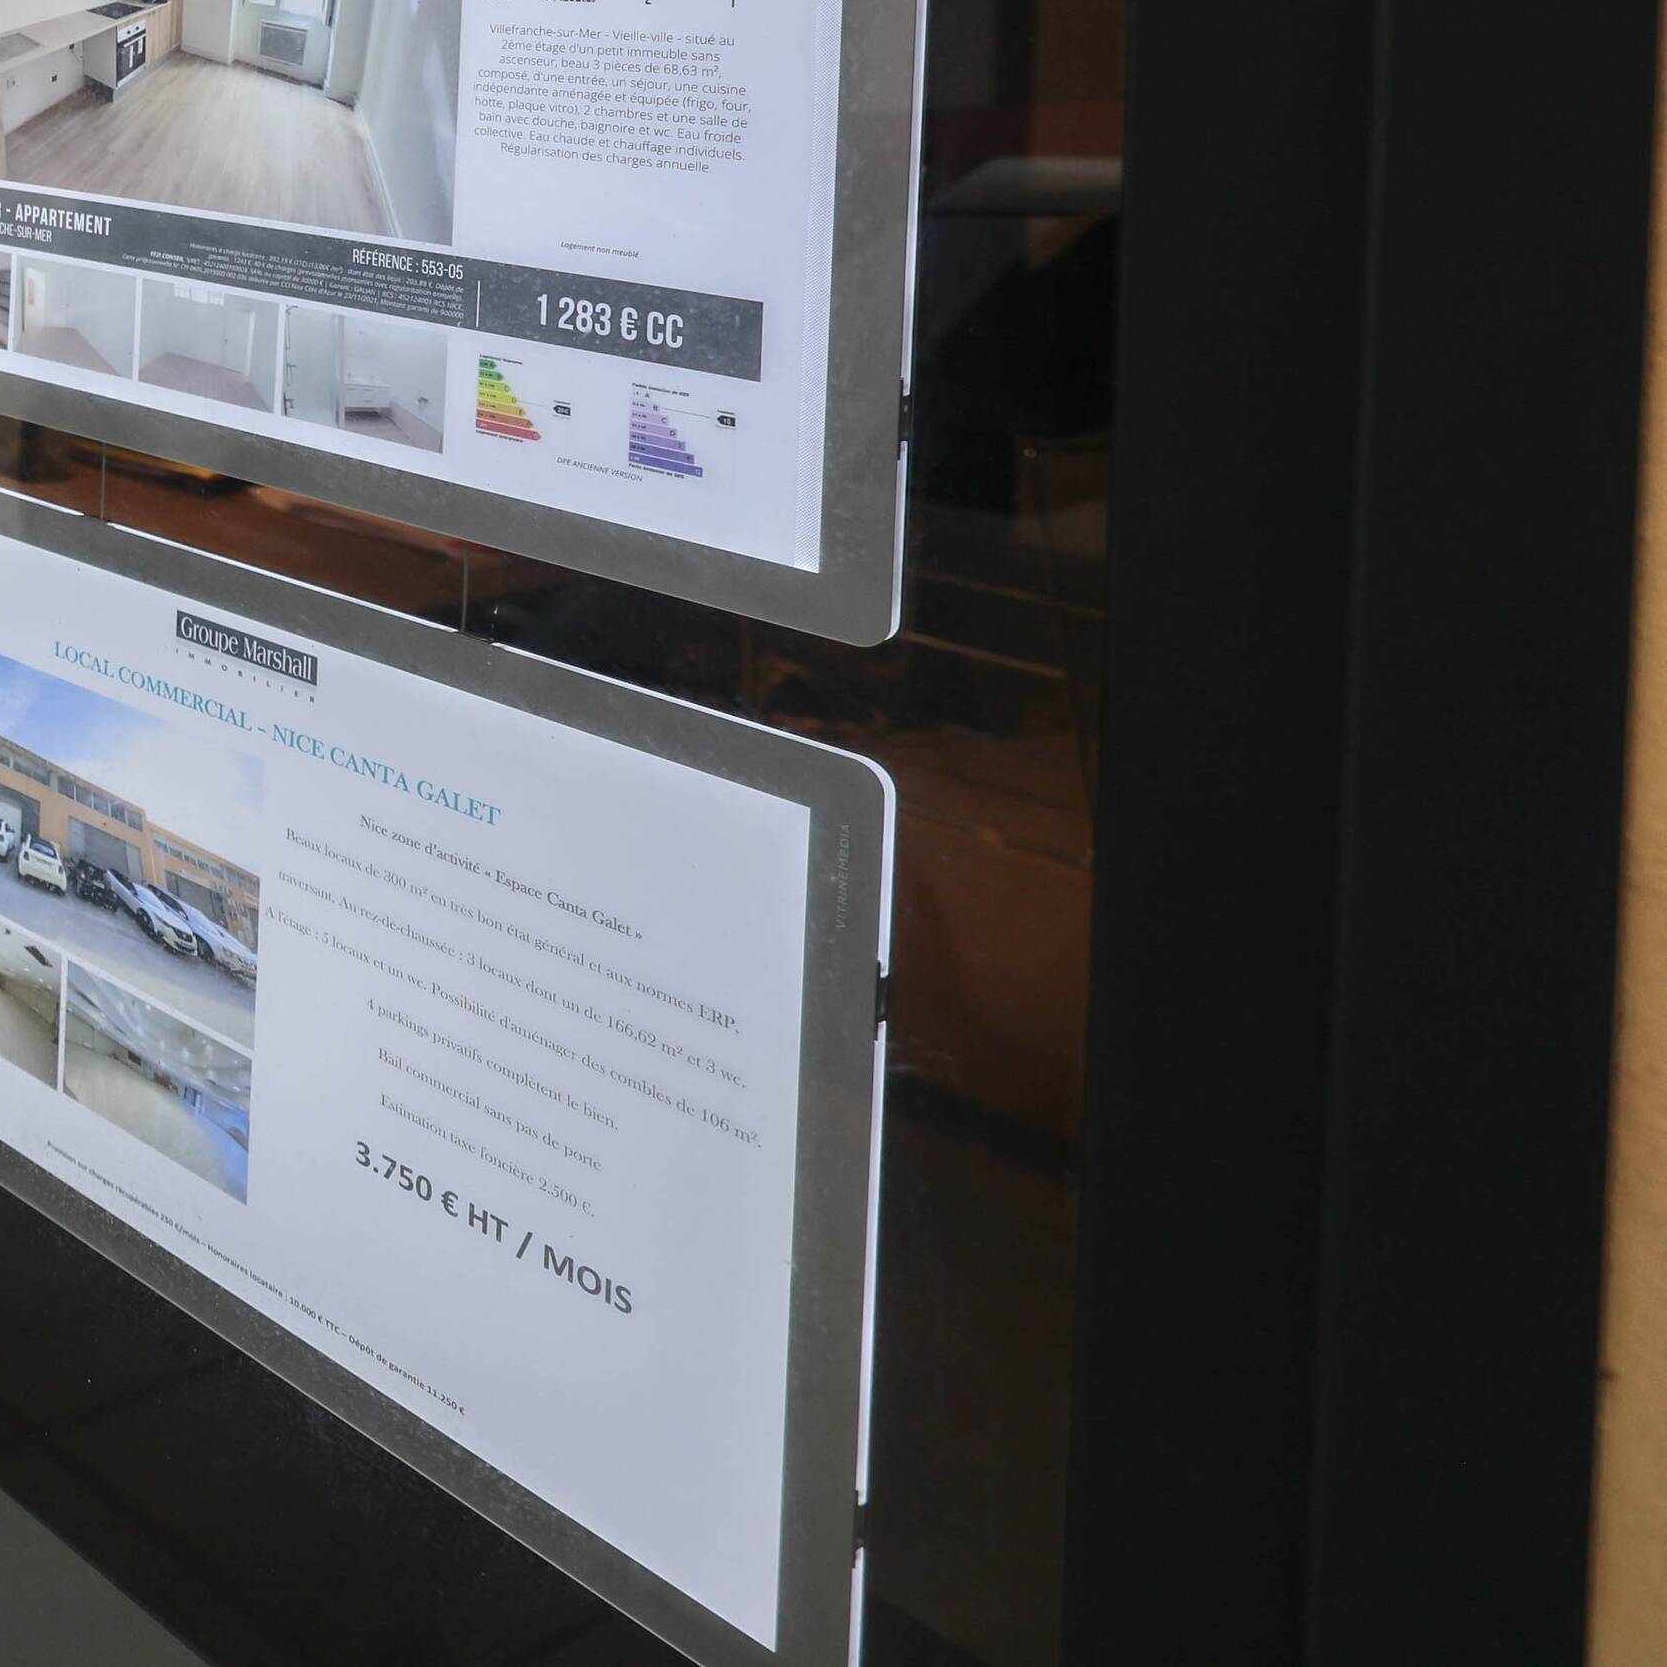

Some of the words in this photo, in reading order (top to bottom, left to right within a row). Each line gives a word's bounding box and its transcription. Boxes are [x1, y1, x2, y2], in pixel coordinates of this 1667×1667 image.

[489, 23, 602, 40] Villefranche-sur-Mer
[611, 29, 674, 44] Vieille-ville
[684, 33, 716, 46] situé
[718, 36, 735, 47] au
[14, 202, 112, 236] APPARTEMENT
[352, 247, 414, 272] RÉFÉRENCE
[420, 258, 464, 280] 553-05
[536, 293, 548, 326] 1
[557, 296, 612, 336] 283
[619, 306, 640, 341] €
[646, 310, 684, 349] CC
[175, 647, 315, 704] IMMOBILIER
[180, 615, 239, 656] Groupe
[243, 636, 313, 681] Marshall
[54, 639, 115, 679] LOCAL
[119, 664, 252, 733] COMMERCIAL
[272, 723, 325, 760] NICE
[329, 746, 410, 793] CANTA
[416, 779, 501, 826] GALET
[360, 813, 388, 837] Nice
[391, 830, 421, 851] zone
[424, 841, 480, 875] d'activité
[495, 869, 543, 900] Espace
[546, 891, 588, 919] Canta
[591, 909, 632, 937] Galet
[834, 823, 851, 929] VITRINEMEDIA
[285, 826, 322, 854] Beaux
[324, 843, 362, 871] locaux
[364, 862, 380, 879] de
[382, 869, 407, 889] 300
[409, 883, 429, 901] m²
[431, 895, 447, 908] en
[450, 899, 474, 919] très
[477, 908, 503, 932] bon
[506, 923, 531, 944] état
[534, 937, 584, 967] général
[588, 961, 601, 974] et
[605, 968, 632, 988] aux
[636, 981, 693, 1013] normes
[698, 1003, 740, 1035] ERP,
[378, 1046, 402, 1071] Bail
[405, 1065, 480, 1110] commercial
[483, 1104, 512, 1126] sans
[515, 1120, 538, 1139] pas
[541, 1132, 559, 1150] de
[563, 1144, 601, 1171] porte
[379, 1093, 446, 1139] Estimation
[450, 1132, 476, 1154] taxe
[480, 1146, 534, 1184] foncière
[538, 1176, 578, 1208] 2.500
[581, 1200, 595, 1218] €.
[355, 1140, 432, 1202] 3.750
[440, 1190, 459, 1218] €
[468, 1201, 509, 1243] HT
[543, 1243, 632, 1314] MOIS
